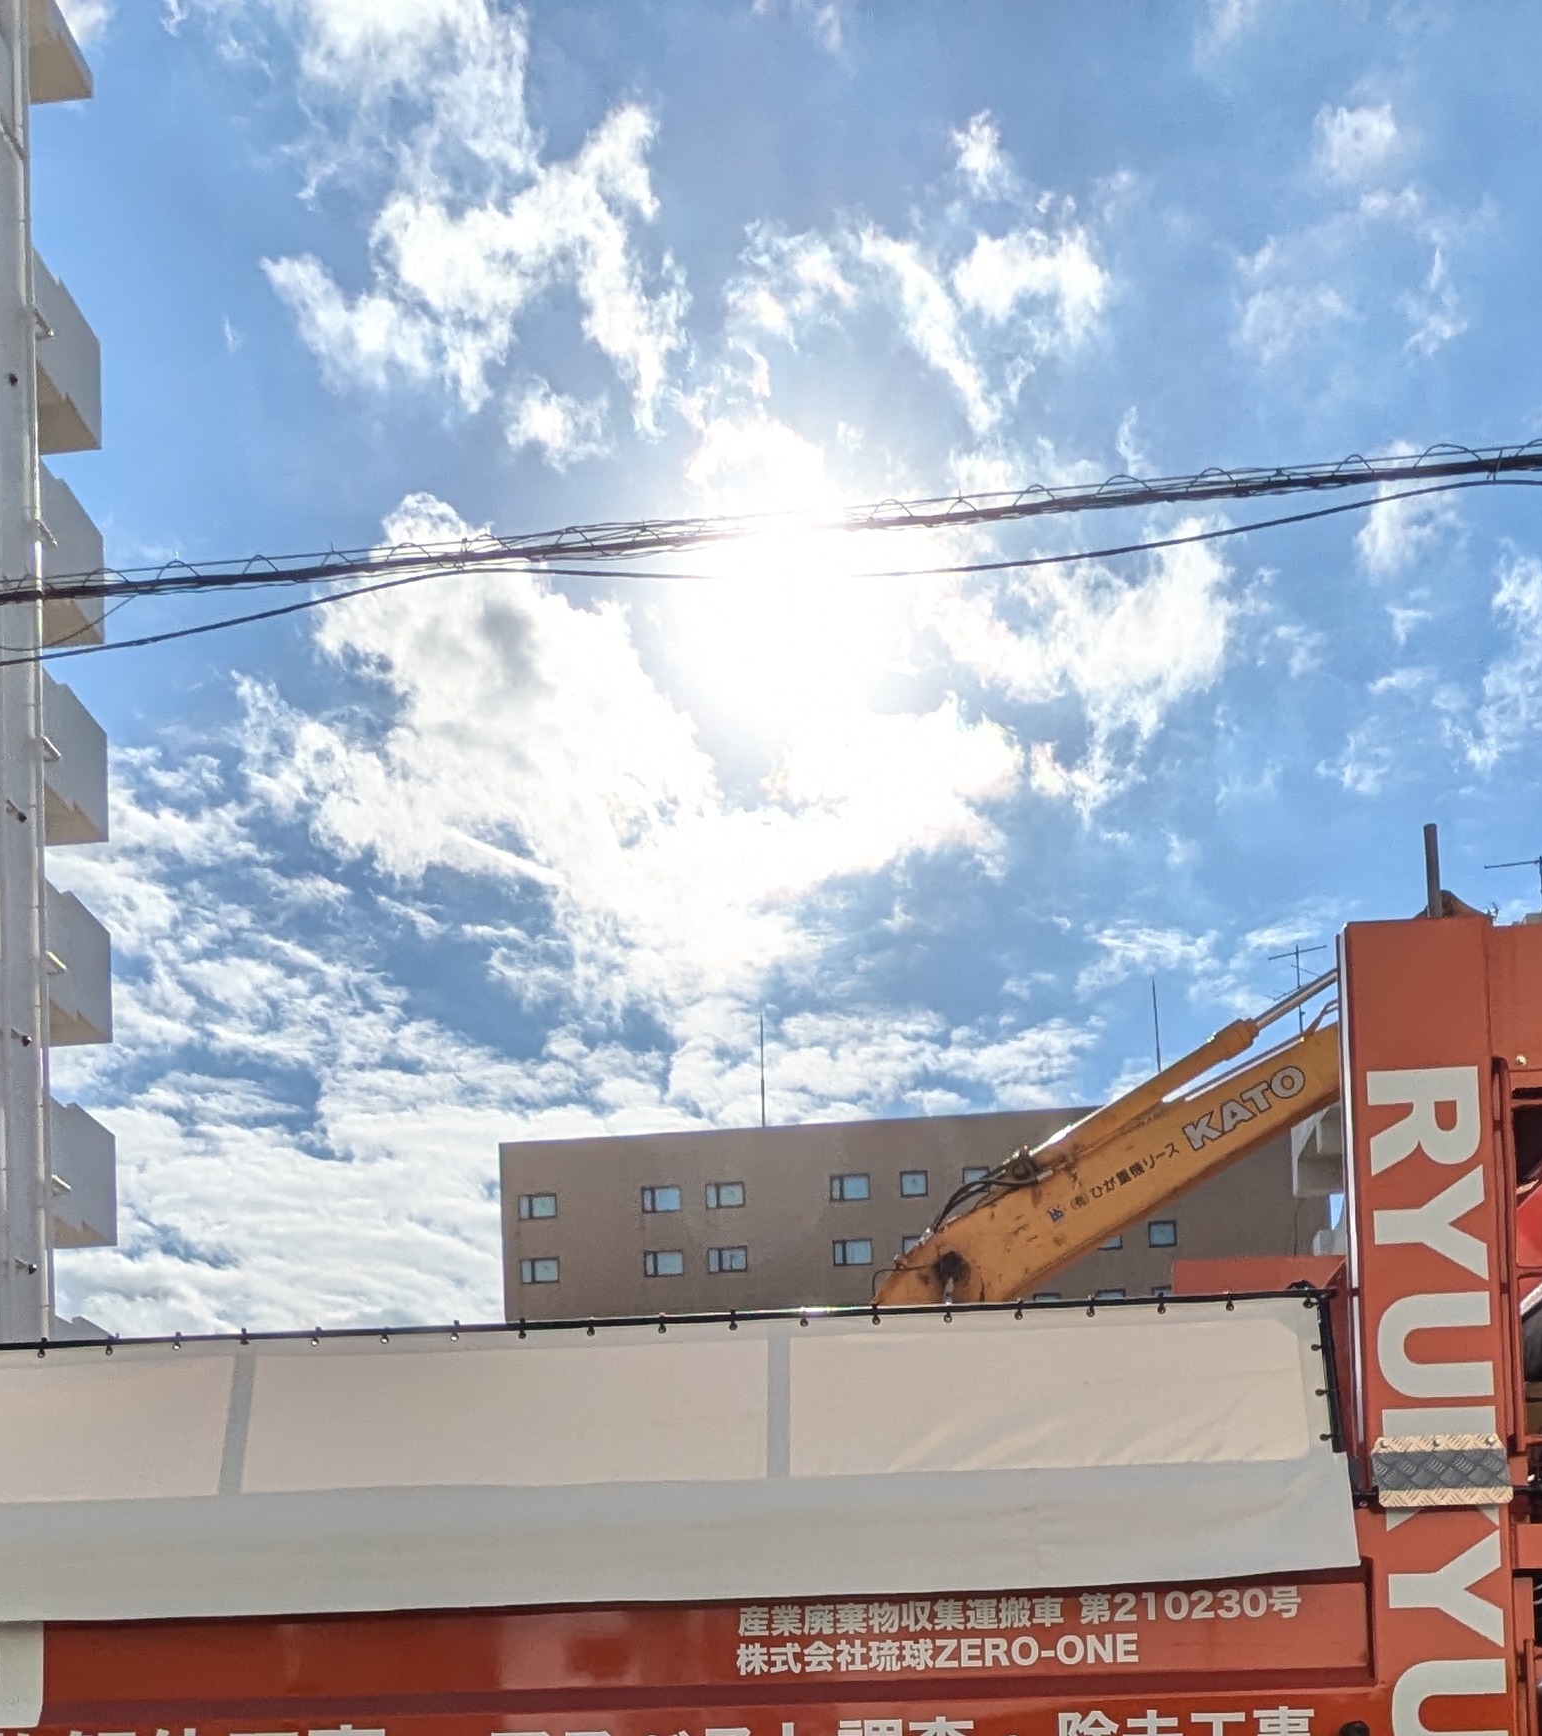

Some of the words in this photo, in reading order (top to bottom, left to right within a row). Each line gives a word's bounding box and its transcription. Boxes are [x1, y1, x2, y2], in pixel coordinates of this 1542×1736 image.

[1182, 1065, 1306, 1151] KATO
[737, 1595, 1065, 1637] 産業廃棄物収集運搬車
[1079, 1586, 1302, 1625] 第210230号
[736, 1632, 1140, 1675] 株式会社琉球ZERO-ONE
